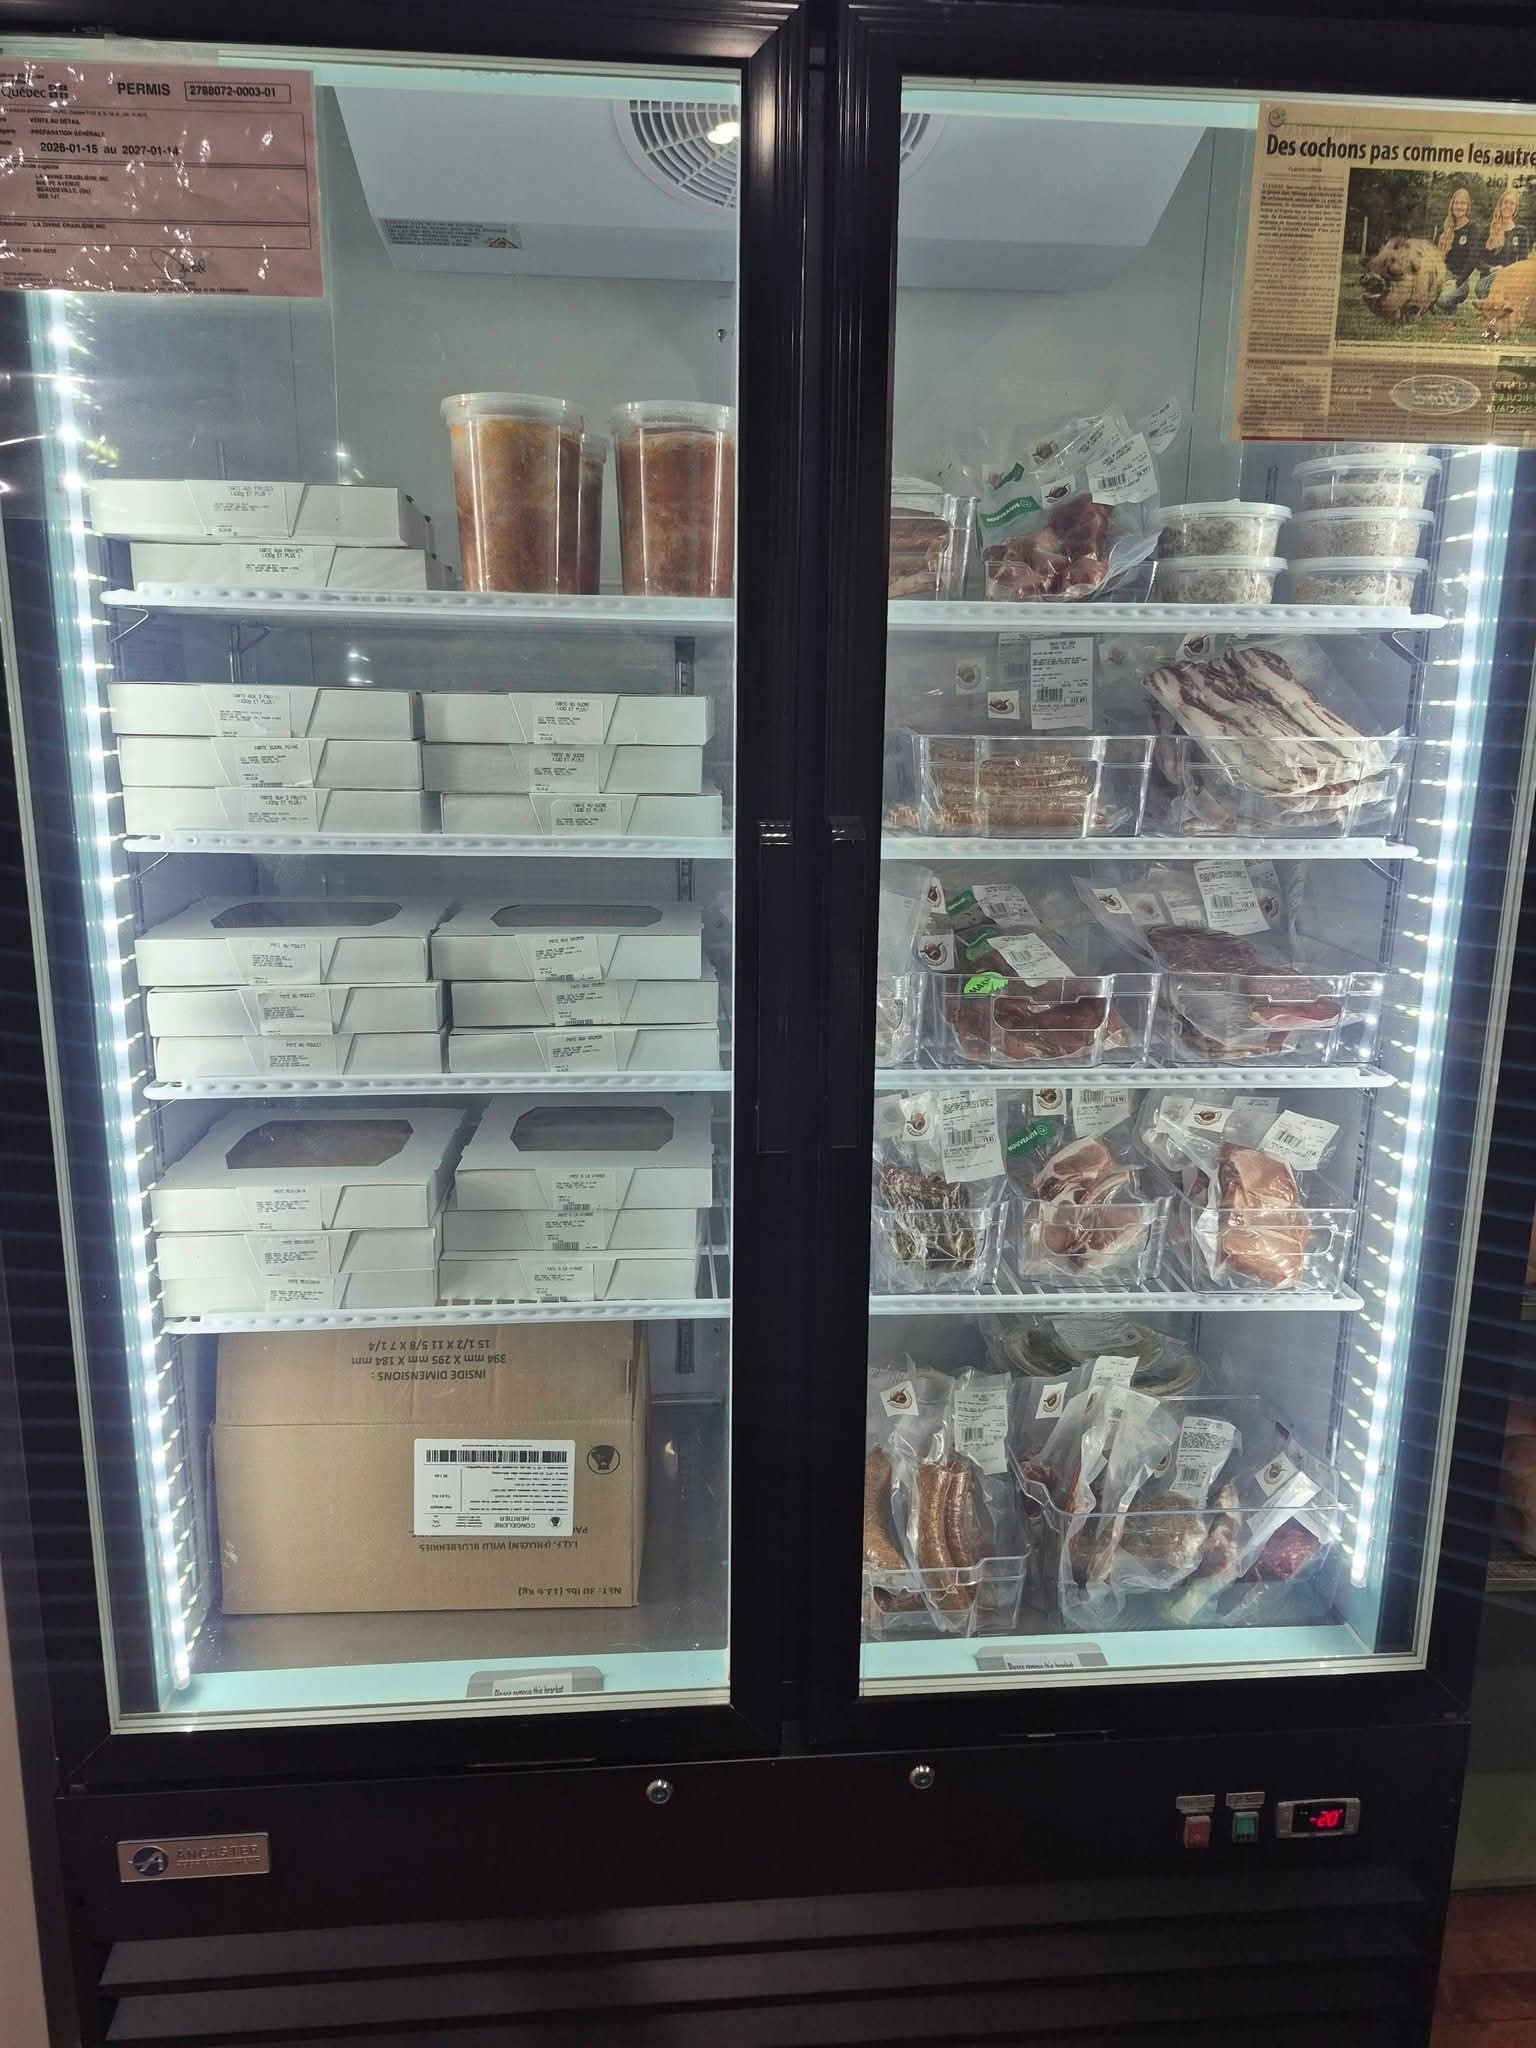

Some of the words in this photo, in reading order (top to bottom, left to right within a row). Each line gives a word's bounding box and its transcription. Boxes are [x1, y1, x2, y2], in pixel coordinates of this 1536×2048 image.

[117, 82, 171, 97] PERMIS
[40, 141, 98, 154] 2026-01-15
[103, 146, 117, 155] au
[122, 145, 180, 156] 2027-01-14
[1266, 133, 1296, 156] Des
[1299, 136, 1367, 160] cochons
[1369, 143, 1400, 165] pas
[1402, 145, 1464, 163] comme
[1467, 143, 1491, 164] les
[368, 1340, 387, 1352] 1/4
[391, 1341, 397, 1351] 7
[400, 1341, 407, 1351] X
[410, 1340, 428, 1352] 5/8
[431, 1340, 443, 1350] 11
[447, 1340, 455, 1350] X
[457, 1339, 475, 1351] 1/2
[477, 1339, 489, 1349] 15
[352, 1357, 372, 1365] mm
[375, 1356, 395, 1366] 184
[397, 1356, 405, 1366] X
[408, 1355, 429, 1364] mm
[432, 1355, 450, 1365] 295
[453, 1355, 461, 1365] X
[464, 1355, 484, 1363] mm
[487, 1354, 506, 1364] 394
[378, 1370, 449, 1381] DIMENSIONS
[451, 1369, 486, 1380] INSIDE
[419, 1543, 481, 1552] BLUEBERRIES
[482, 1542, 507, 1550] WILD
[176, 1844, 259, 1859] ANCASTER
